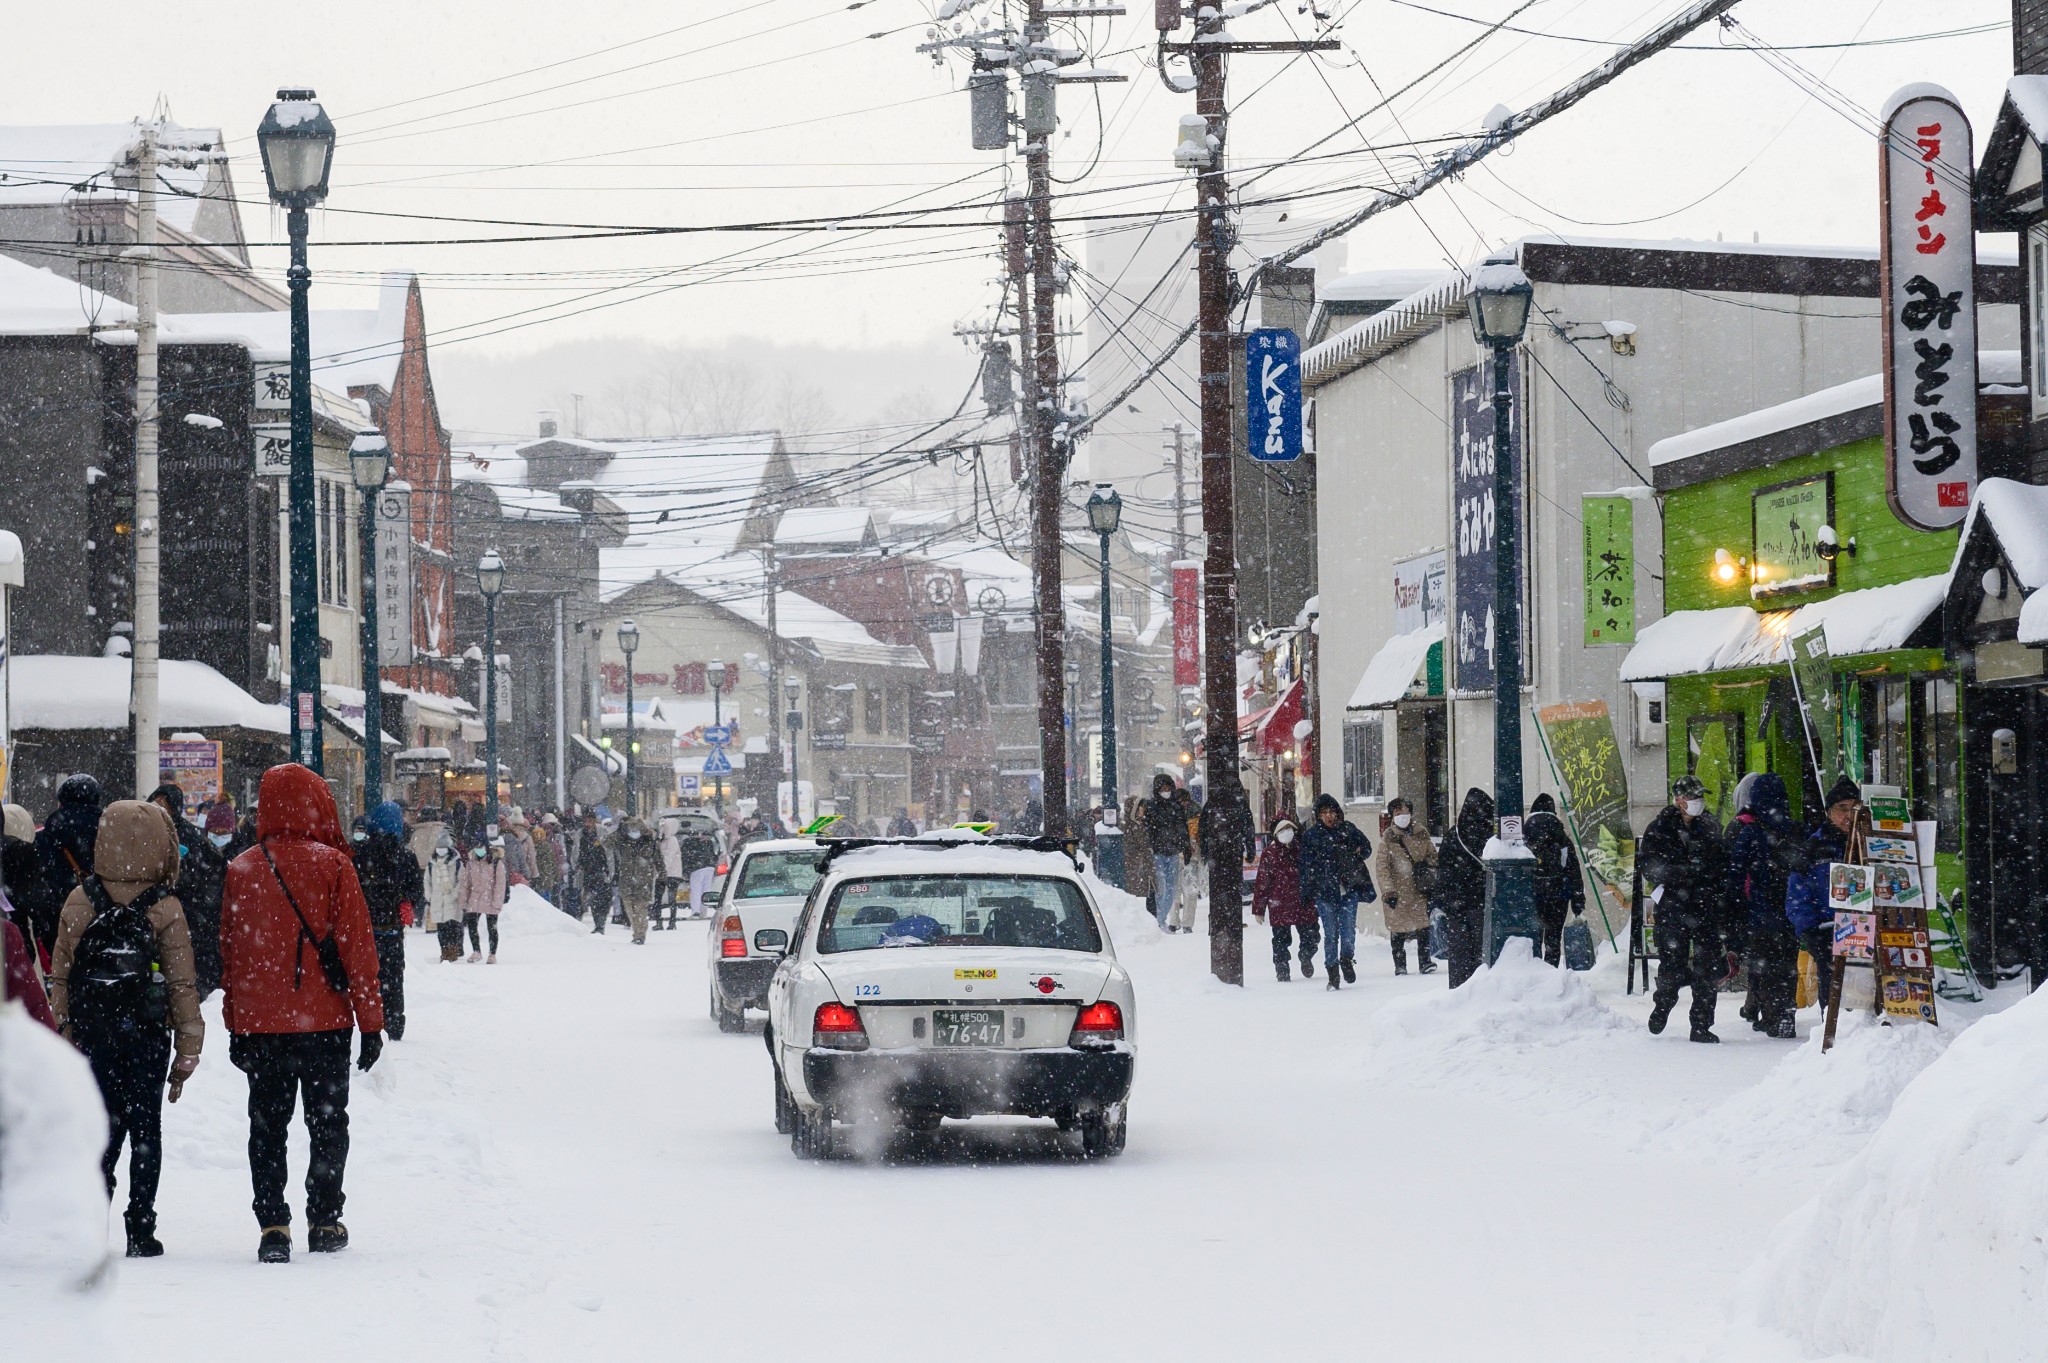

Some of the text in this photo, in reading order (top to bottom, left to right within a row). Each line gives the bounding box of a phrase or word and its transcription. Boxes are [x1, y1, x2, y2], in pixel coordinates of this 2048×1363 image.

[1914, 122, 1947, 254] ラーメン
[1259, 336, 1288, 349] 染織
[1901, 274, 1964, 476] みとら
[1261, 353, 1289, 455] Kazu
[1460, 487, 1495, 558] おみや
[683, 776, 697, 788] P
[856, 984, 881, 996] 122
[948, 1024, 1001, 1043] 76-47
